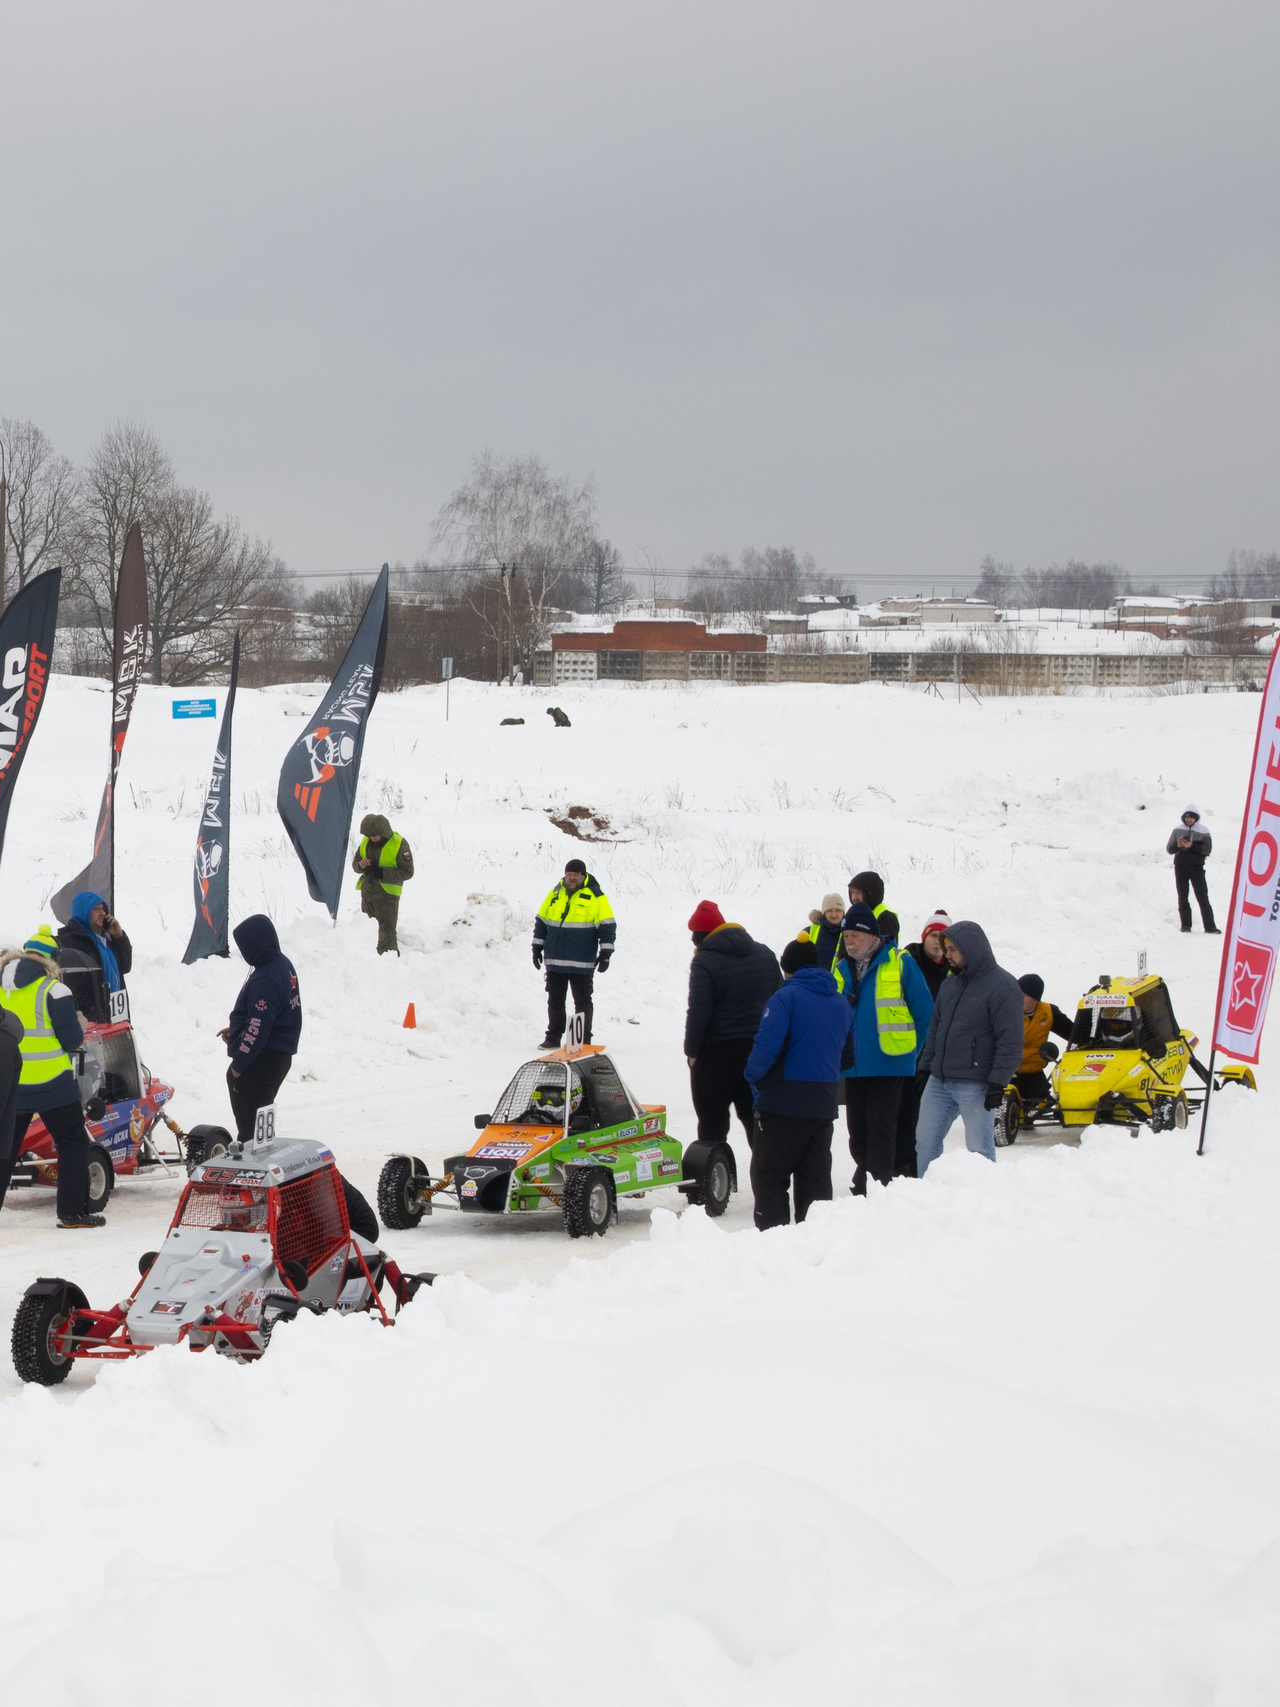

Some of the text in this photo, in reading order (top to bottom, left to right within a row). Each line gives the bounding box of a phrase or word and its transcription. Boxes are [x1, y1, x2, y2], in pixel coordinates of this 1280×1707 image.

[114, 625, 138, 722] MSK
[111, 992, 125, 1017] 19
[239, 1017, 261, 1054] ЦСКА
[568, 1015, 583, 1046] 10
[1140, 1077, 1151, 1091] 81
[256, 1109, 274, 1145] 88
[620, 1127, 637, 1137] RUSTA
[478, 1148, 528, 1157] LIQUI
[203, 1167, 239, 1183] GS
[234, 1177, 262, 1185] TEAM
